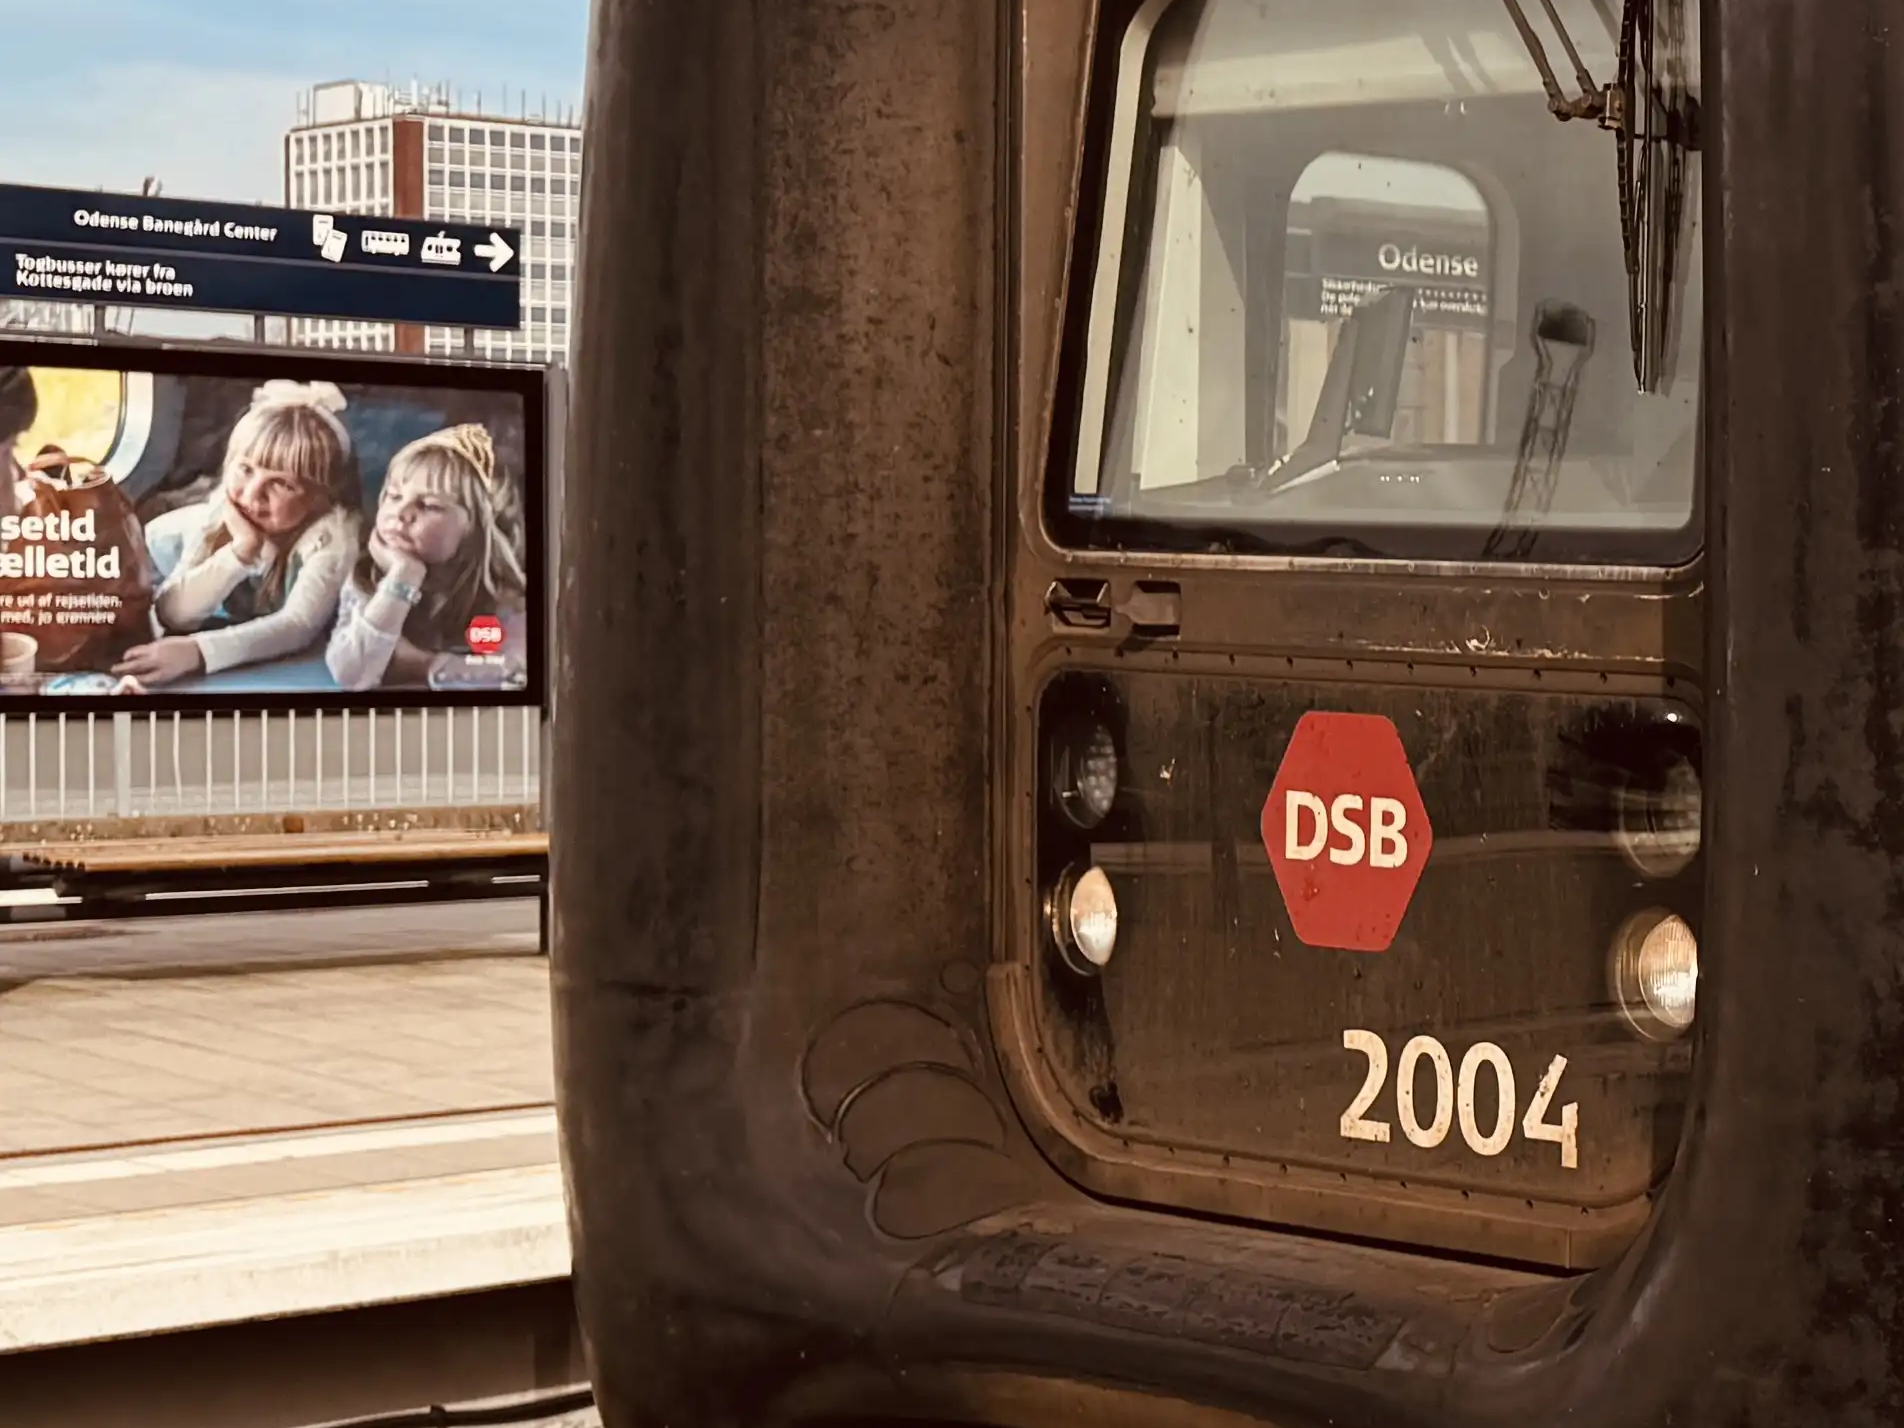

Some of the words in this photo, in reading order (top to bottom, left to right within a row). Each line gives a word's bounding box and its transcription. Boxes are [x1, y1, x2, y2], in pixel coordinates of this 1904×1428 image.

[74, 209, 139, 231] Odense
[143, 215, 220, 237] Banegård
[223, 222, 278, 242] Center
[15, 253, 103, 275] Togbusser
[153, 263, 176, 280] fra
[1379, 244, 1478, 277] Odense
[116, 278, 142, 293] via
[145, 278, 193, 297] broen
[470, 626, 502, 643] DSB
[1285, 789, 1409, 869] DSB
[1340, 1028, 1579, 1169] 2004
